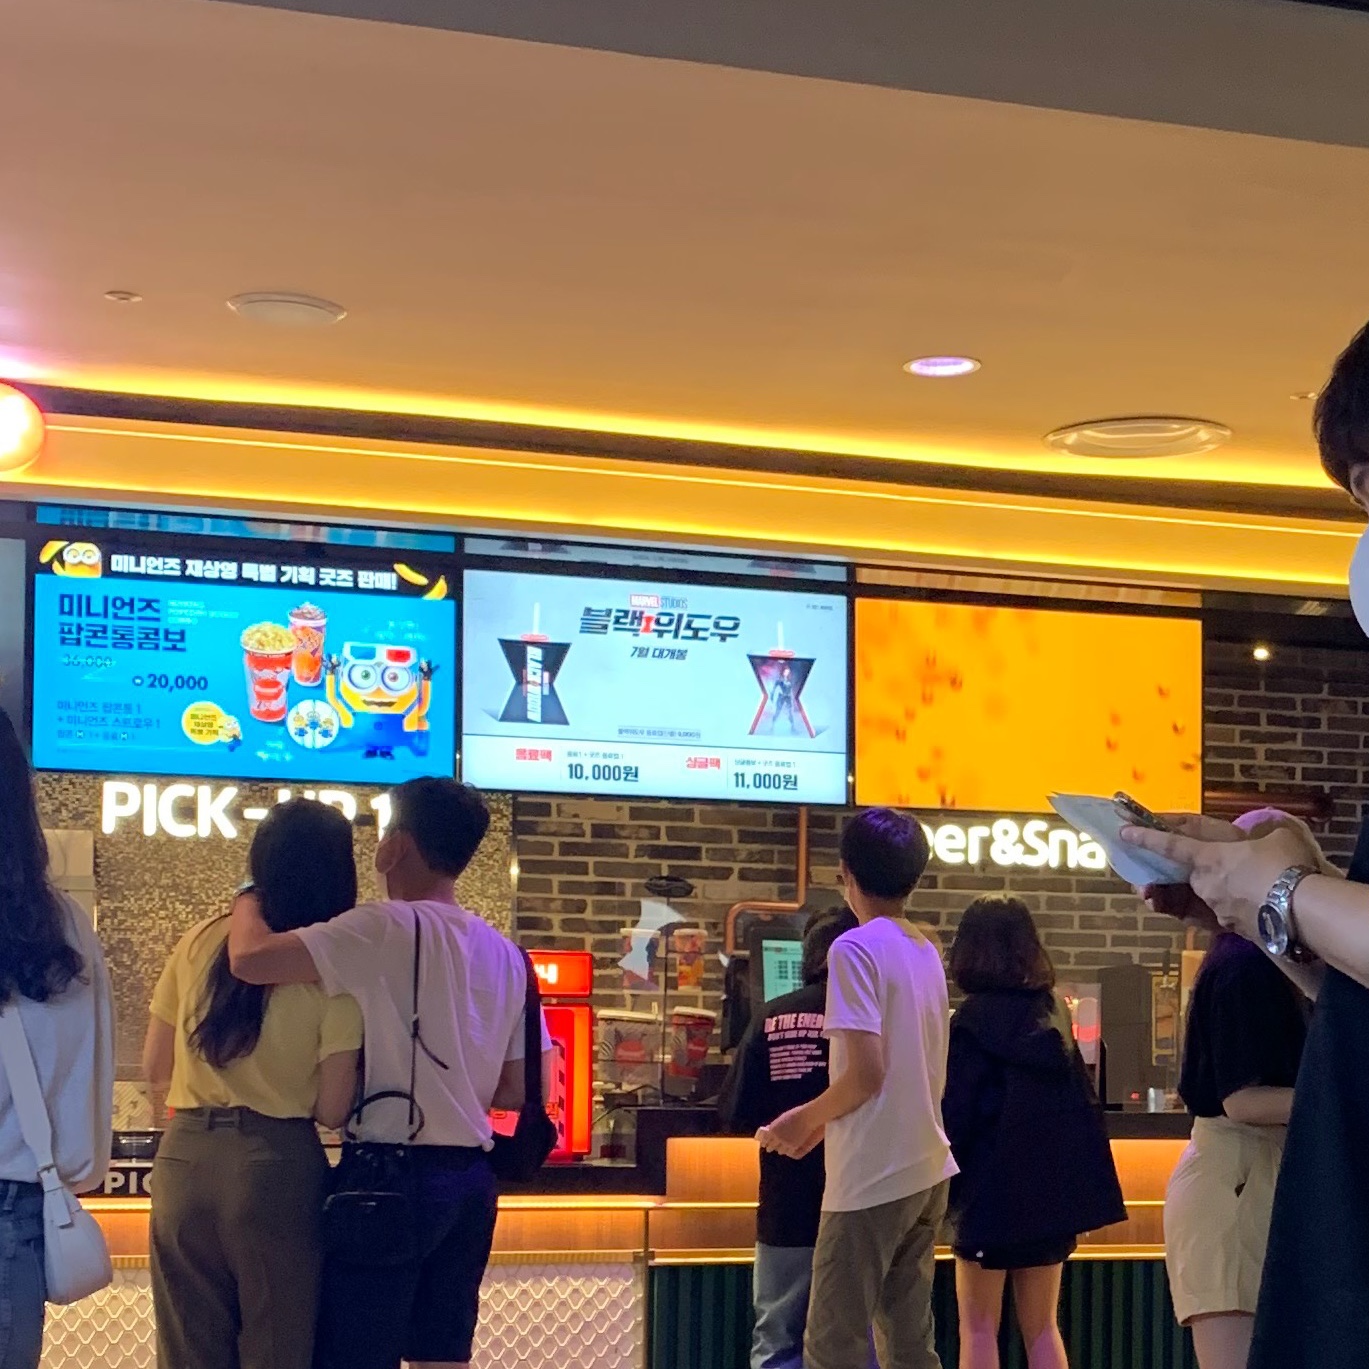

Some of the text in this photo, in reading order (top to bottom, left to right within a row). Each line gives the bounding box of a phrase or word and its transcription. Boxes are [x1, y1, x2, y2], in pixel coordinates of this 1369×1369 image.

[110, 554, 398, 591] 미니언즈 재상영 특별 기획 굿즈 판매!
[58, 593, 161, 622] 미니언즈
[58, 622, 187, 652] 팝콘통콤보
[147, 673, 209, 693] 20,000
[567, 763, 640, 783] 10,000원
[733, 771, 799, 791] 11,000원
[777, 1013, 797, 1030] THE
